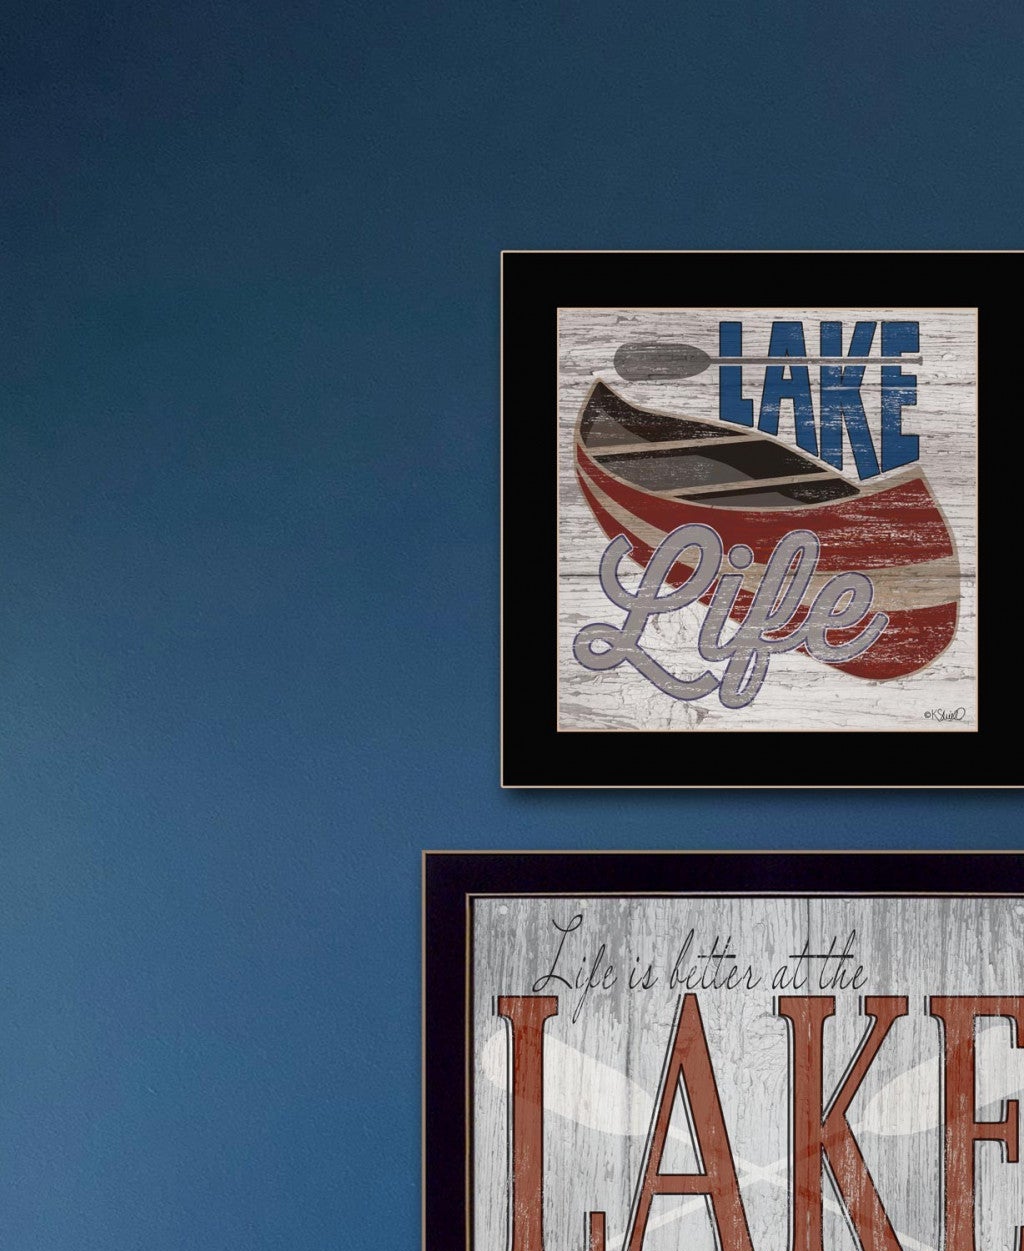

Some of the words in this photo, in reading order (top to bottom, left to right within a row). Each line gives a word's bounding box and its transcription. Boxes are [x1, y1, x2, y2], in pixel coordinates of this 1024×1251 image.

[719, 321, 921, 481] LAKE
[573, 523, 889, 710] Life
[532, 914, 617, 1024] Life
[629, 956, 658, 990] is
[669, 928, 762, 990] better
[771, 939, 812, 990] at
[817, 929, 869, 990] the
